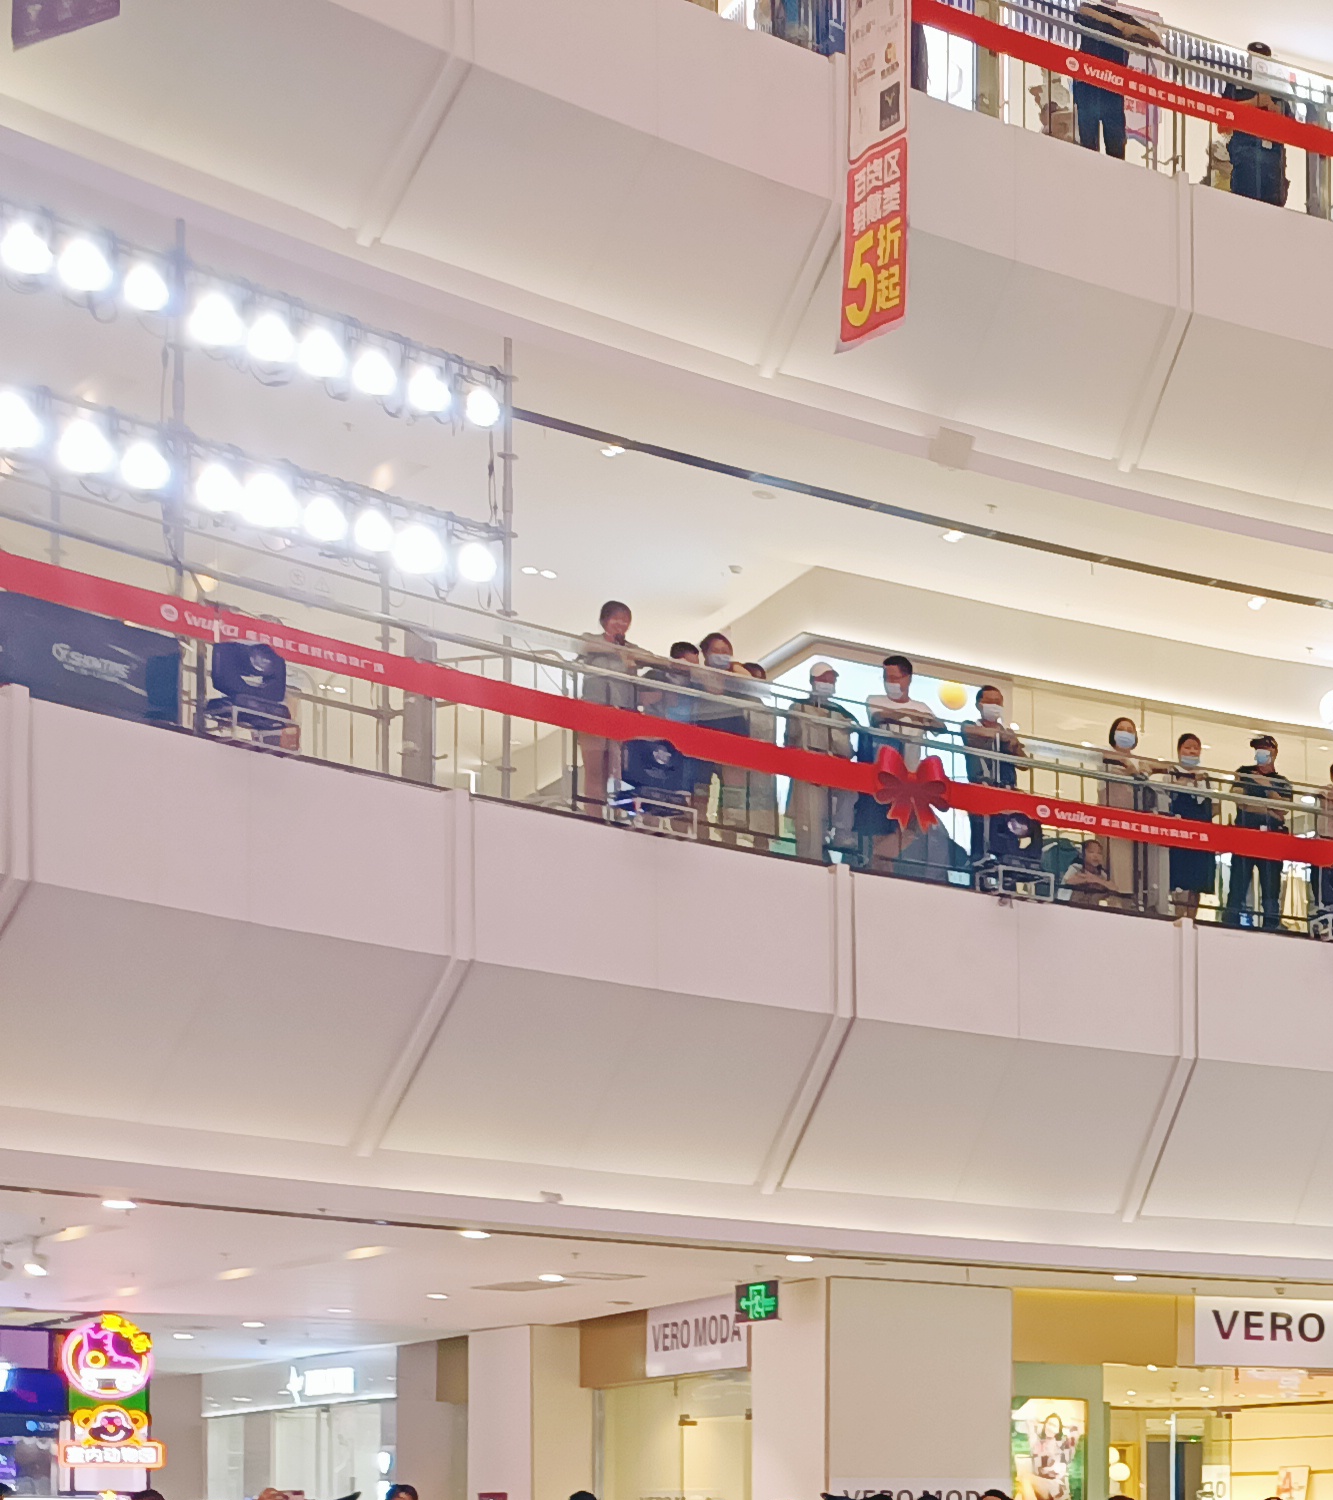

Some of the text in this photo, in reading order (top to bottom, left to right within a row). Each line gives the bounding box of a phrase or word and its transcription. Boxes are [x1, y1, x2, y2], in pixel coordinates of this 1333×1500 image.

[845, 230, 875, 328] 5
[652, 1313, 742, 1352] VERO MODA
[1212, 1309, 1325, 1343] VERO
